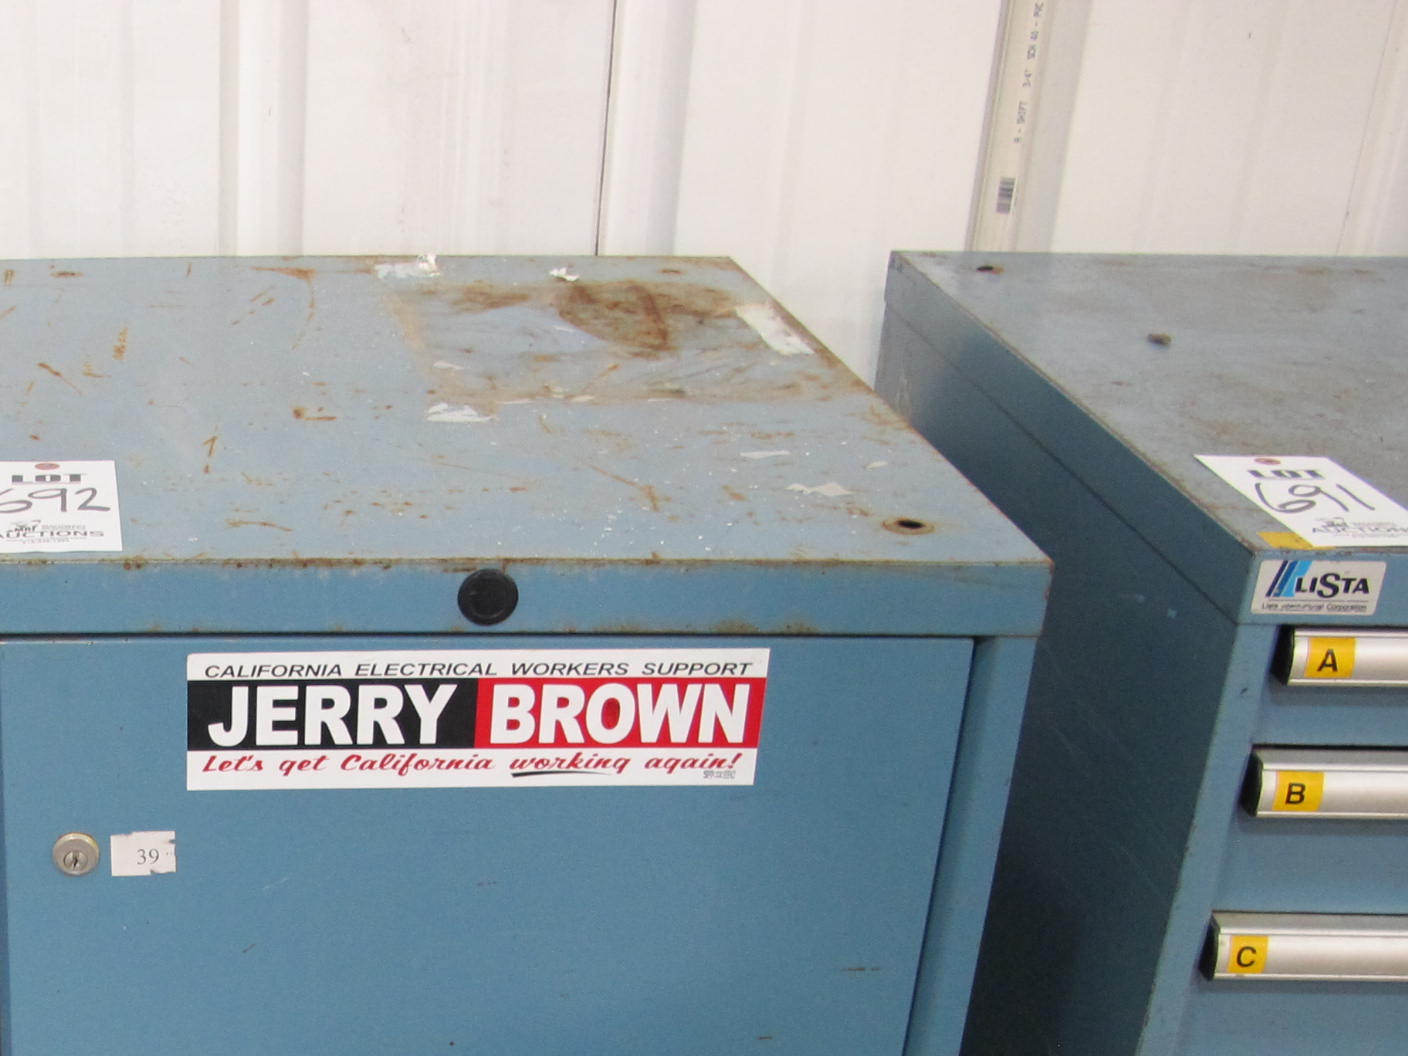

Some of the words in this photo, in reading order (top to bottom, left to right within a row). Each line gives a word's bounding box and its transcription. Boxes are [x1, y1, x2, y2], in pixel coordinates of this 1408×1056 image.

[11, 473, 82, 485] LOT
[1254, 483, 1376, 514] 691
[204, 663, 343, 679] CALIFORNIA
[354, 662, 498, 677] ELECTRICAL
[511, 661, 630, 677] WORKERS
[641, 661, 754, 676] SUPPORT
[1317, 648, 1339, 673] A
[207, 683, 458, 747] JERRY
[490, 682, 750, 745] BROWN
[202, 755, 264, 773] Let's
[279, 754, 330, 777] get
[339, 752, 495, 777] California
[509, 751, 632, 775] working
[643, 752, 743, 775] again!
[1284, 782, 1307, 805] B
[136, 848, 160, 865] 39
[1235, 946, 1258, 968] C
